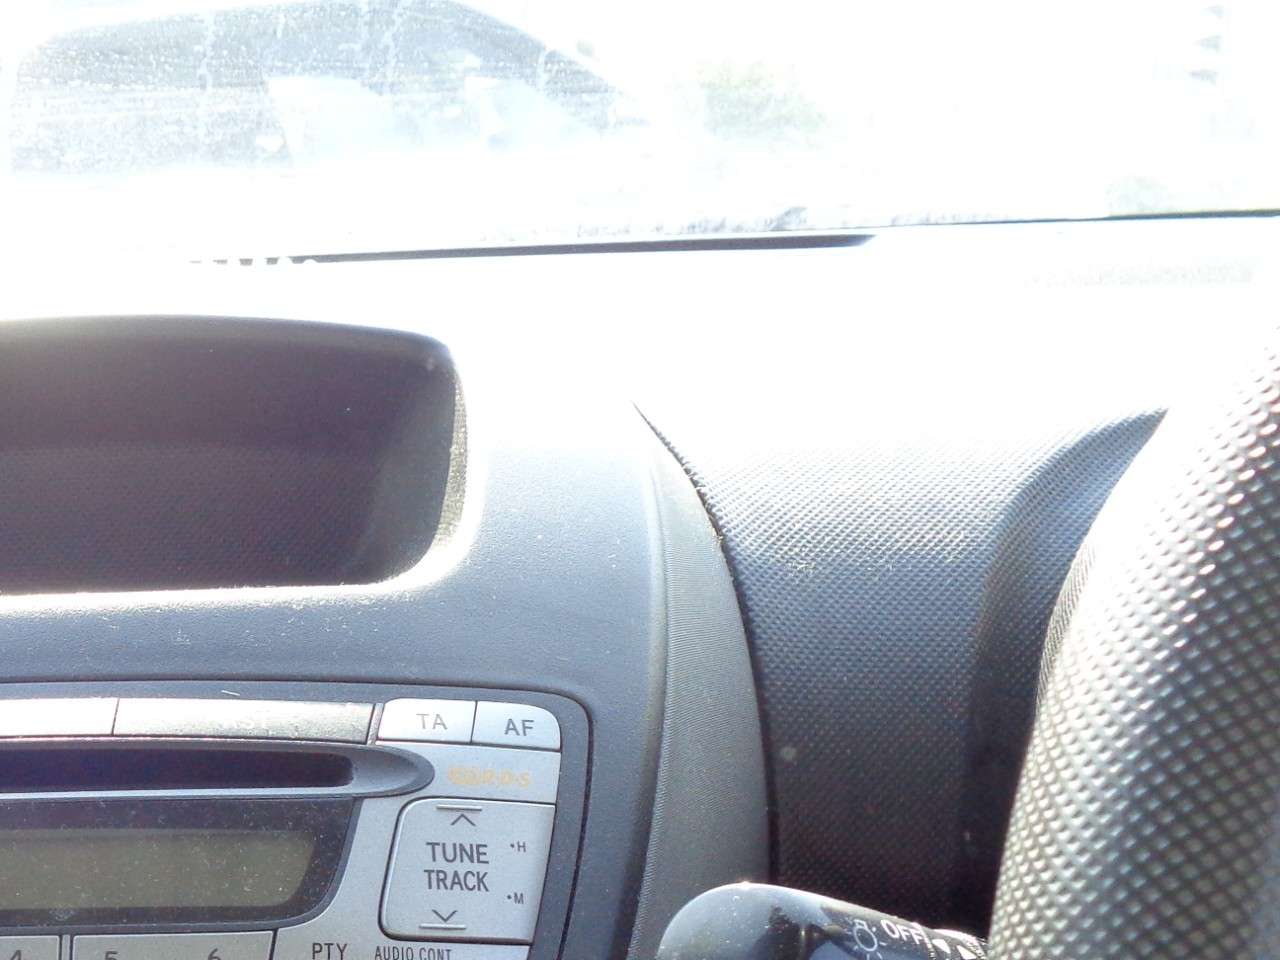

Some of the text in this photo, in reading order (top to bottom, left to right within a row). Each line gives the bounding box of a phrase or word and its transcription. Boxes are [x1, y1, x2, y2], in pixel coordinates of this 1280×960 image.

[417, 713, 448, 731] TA
[505, 718, 534, 737] AF
[426, 842, 490, 864] TUNE
[424, 869, 490, 893] TRACK
[880, 919, 923, 945] OFF
[311, 942, 348, 960] PTY
